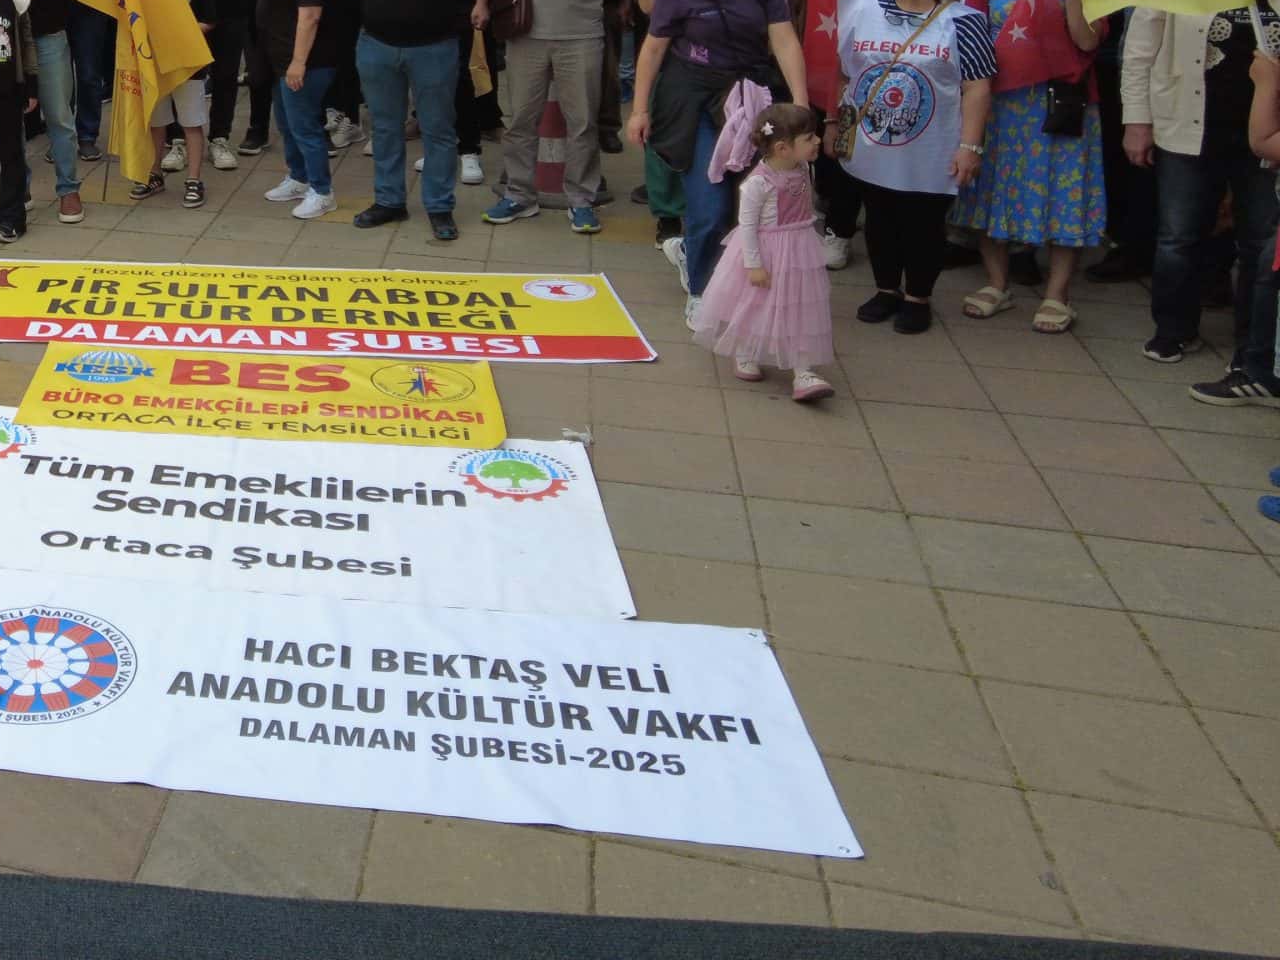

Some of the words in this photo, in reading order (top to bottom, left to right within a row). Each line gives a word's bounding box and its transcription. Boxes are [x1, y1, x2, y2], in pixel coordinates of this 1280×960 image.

[853, 40, 951, 61] BELEDYE-İŞ
[36, 276, 120, 296] PİR
[135, 280, 329, 303] SULTAN
[348, 287, 531, 308] ABDAL
[161, 268, 226, 280] düzen
[231, 271, 259, 281] de
[348, 276, 395, 286] çark
[46, 296, 253, 322] KÜLTÜR
[271, 305, 517, 331] DERNEĞİ
[25, 320, 308, 347] DALAMAN
[326, 332, 542, 356] ŞUBESİ
[53, 362, 158, 376] KESK
[169, 358, 351, 392] BES
[42, 388, 124, 405] BÜRO
[133, 395, 309, 416] EMEKÇİLERİ
[319, 402, 486, 425] SENDİKASI
[52, 408, 176, 425] ORTACA
[186, 415, 253, 432] İLÇE
[261, 421, 471, 441] TEMSİLCİLİĞİ
[20, 453, 135, 483] Tüm
[149, 463, 468, 508] Emeklilerin
[92, 489, 370, 533] Sendikası
[39, 529, 214, 561] Ortaca
[231, 546, 413, 578] Şubesi
[29, 607, 105, 629] ANADOLU
[101, 627, 132, 667] KÜLTÜR
[242, 637, 352, 670] HACI
[370, 648, 548, 692] BEKTAŞ
[562, 662, 672, 695] VELİ
[104, 668, 133, 702] VAKFI
[56, 707, 86, 720] 2025
[166, 670, 386, 714] ANADOLU
[406, 687, 595, 732] KÜLTÜR
[608, 706, 763, 747] VAKFI
[238, 717, 417, 753] DALAMAN
[430, 732, 687, 777] ŞUBESİ-2025
